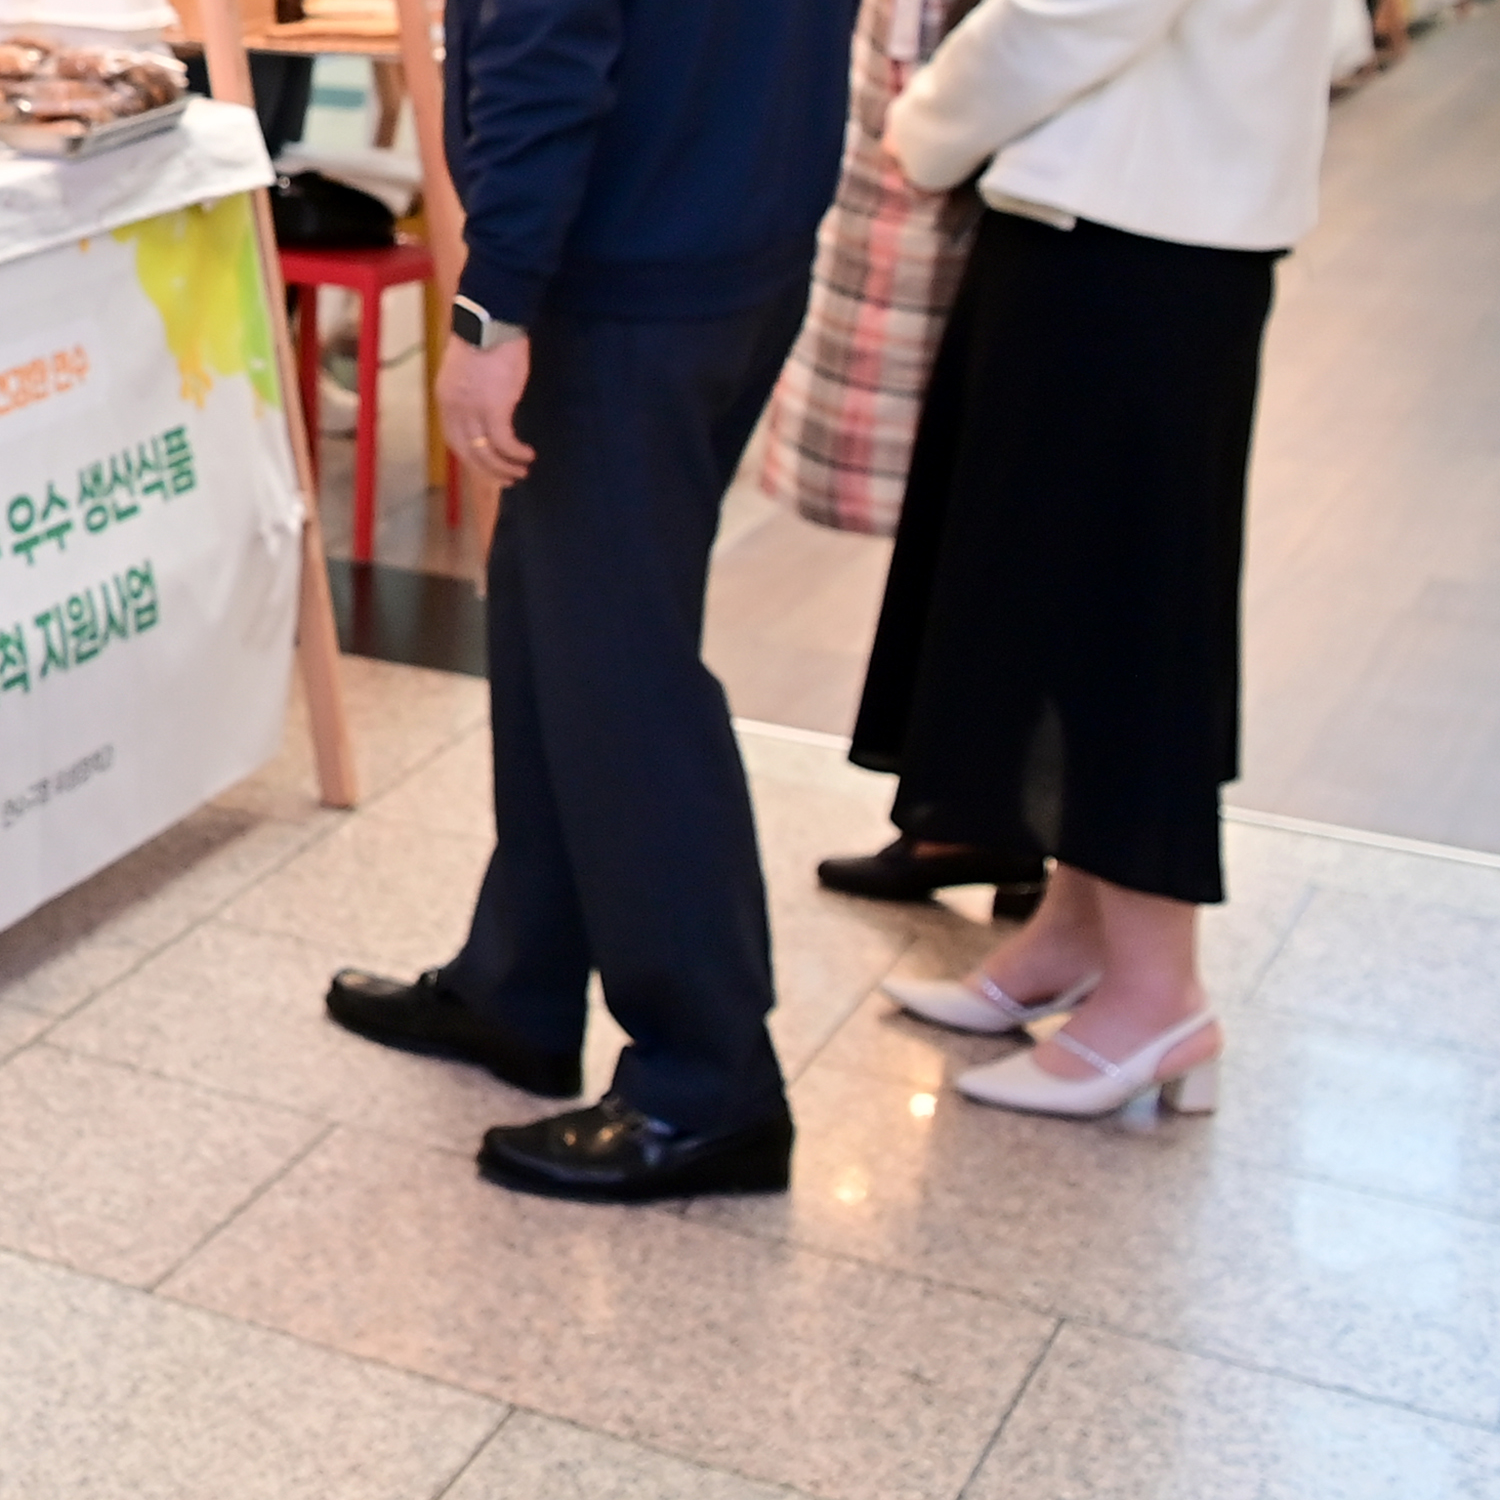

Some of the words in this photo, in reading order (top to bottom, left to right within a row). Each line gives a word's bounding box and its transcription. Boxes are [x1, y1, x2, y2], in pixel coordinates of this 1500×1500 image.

[6, 481, 74, 565] 우수
[77, 423, 197, 534] 생산식품
[33, 558, 161, 680] 지원사업
